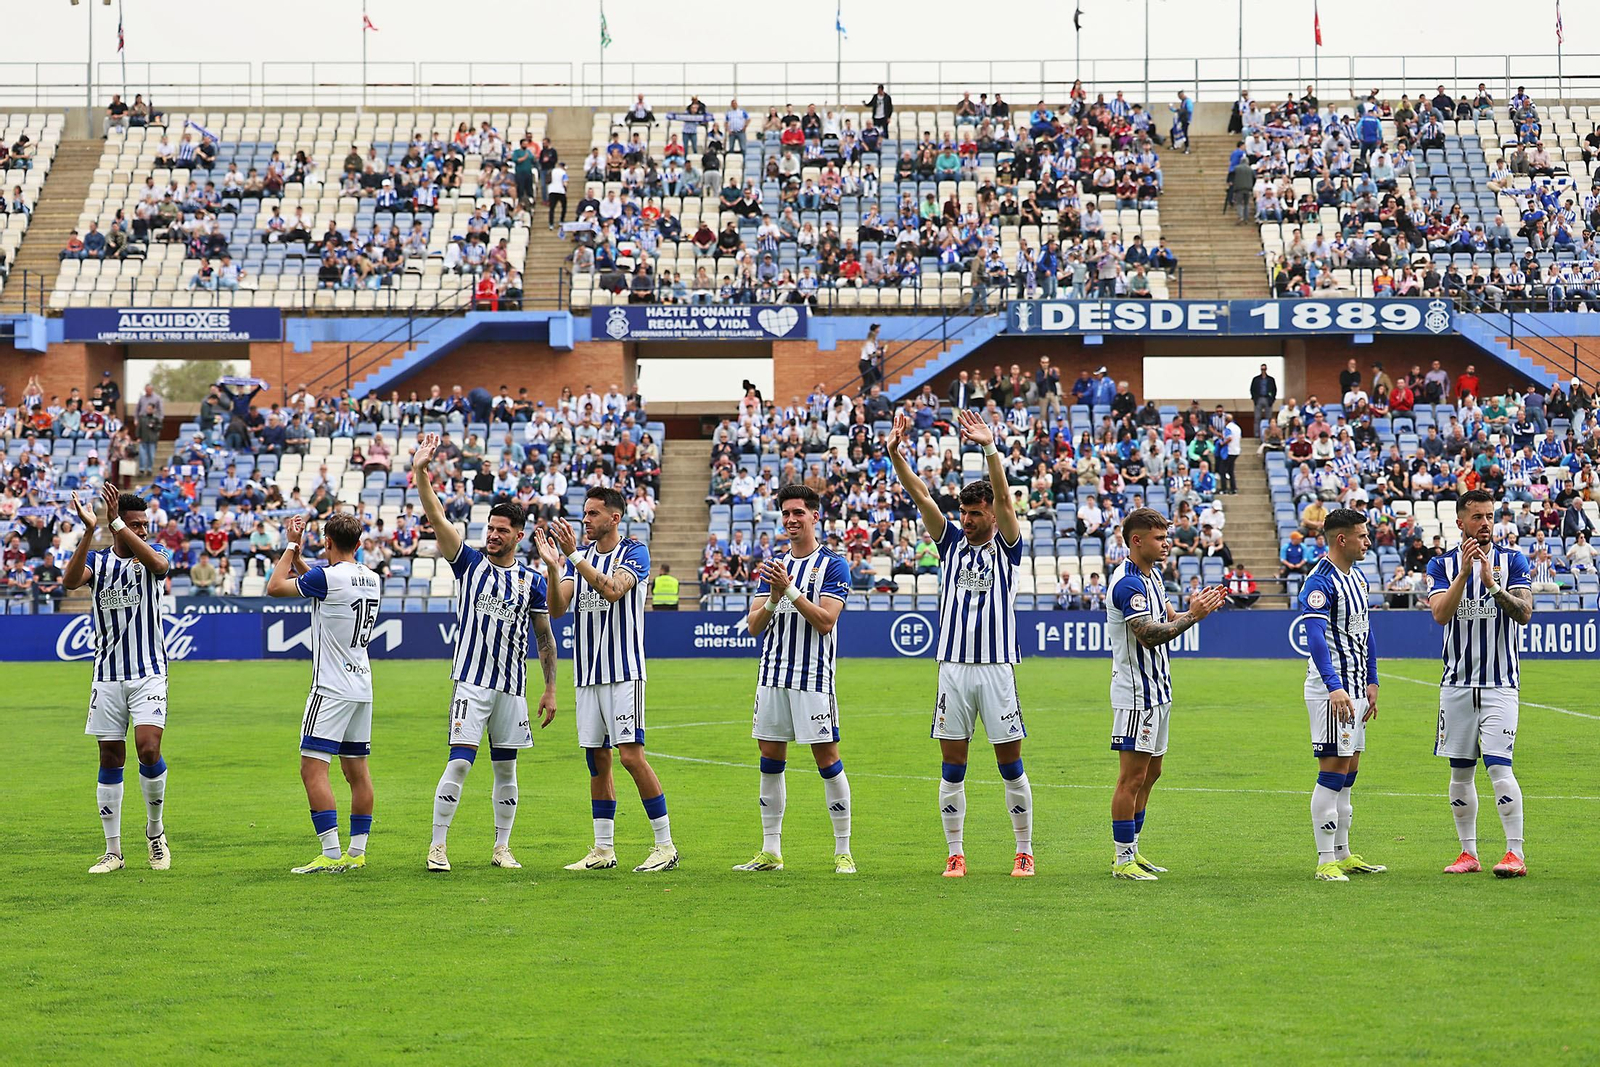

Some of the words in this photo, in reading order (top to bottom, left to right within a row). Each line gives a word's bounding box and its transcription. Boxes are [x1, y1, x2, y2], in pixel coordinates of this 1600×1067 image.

[646, 307, 687, 318] HAZTE
[690, 307, 751, 317] DONANTE
[1041, 302, 1218, 331] DESDE
[1250, 301, 1422, 331] 1889
[119, 312, 230, 329] ALQUIBOXES
[648, 319, 699, 330] REGALA
[719, 319, 749, 329] VIDA
[97, 332, 138, 341] LIMPIEZA
[138, 332, 151, 340] DE
[152, 332, 183, 340] FILTRO
[183, 332, 196, 340] DE
[100, 587, 122, 598] alter
[101, 594, 140, 606] enersun
[478, 593, 502, 605] alter
[579, 599, 609, 608] enersu
[350, 598, 379, 648] 15
[694, 622, 731, 636] alter
[694, 636, 758, 648] enersun
[454, 699, 468, 720] 11
[937, 693, 946, 715] 4
